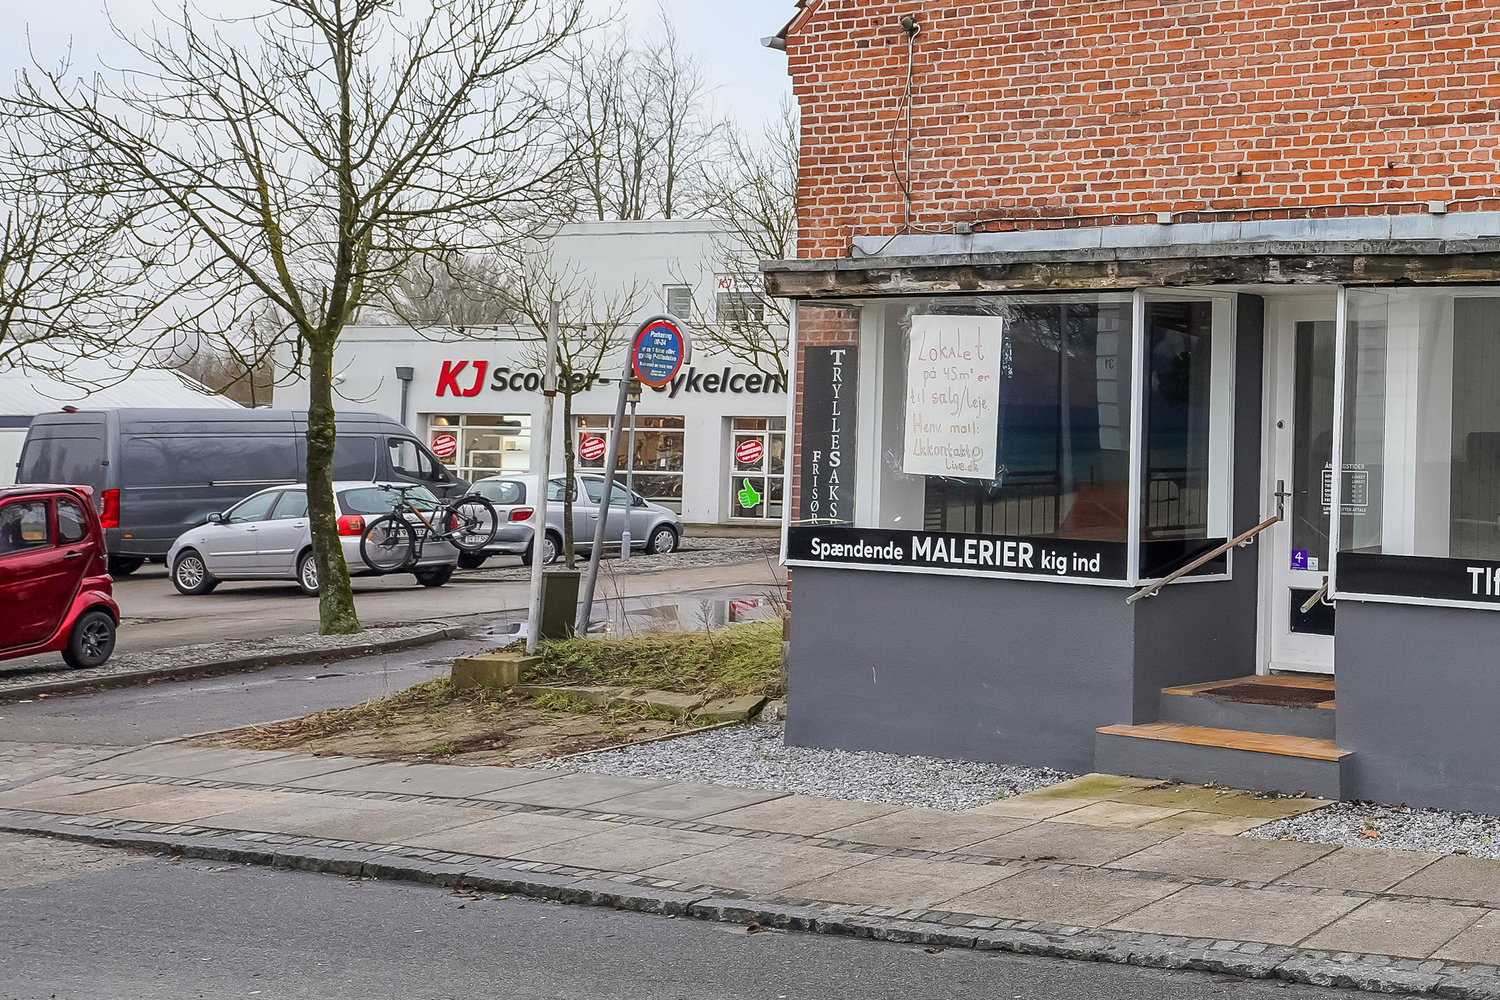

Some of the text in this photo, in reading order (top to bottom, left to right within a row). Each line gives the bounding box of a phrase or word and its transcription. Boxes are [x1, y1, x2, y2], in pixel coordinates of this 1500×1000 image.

[436, 360, 488, 397] KJ
[811, 535, 1101, 575] Spændende MALERIER kig ind
